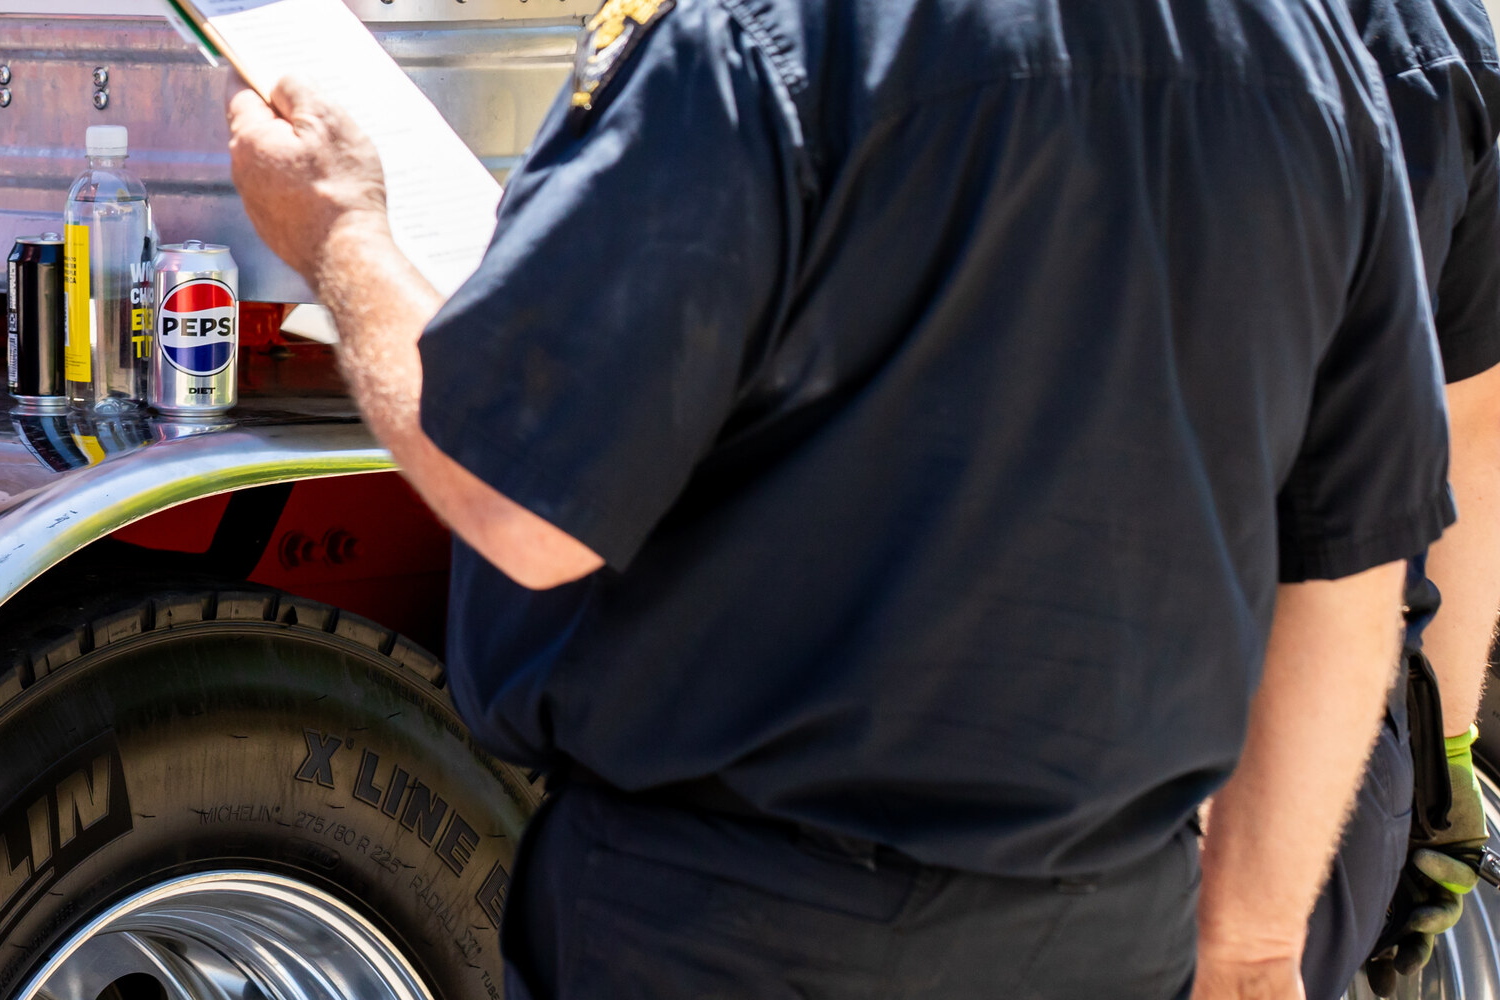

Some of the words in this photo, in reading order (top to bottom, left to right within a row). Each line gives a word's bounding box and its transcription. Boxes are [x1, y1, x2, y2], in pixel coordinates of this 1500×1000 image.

[188, 386, 216, 395] DIET
[353, 748, 481, 878] LINE
[475, 859, 511, 930] E
